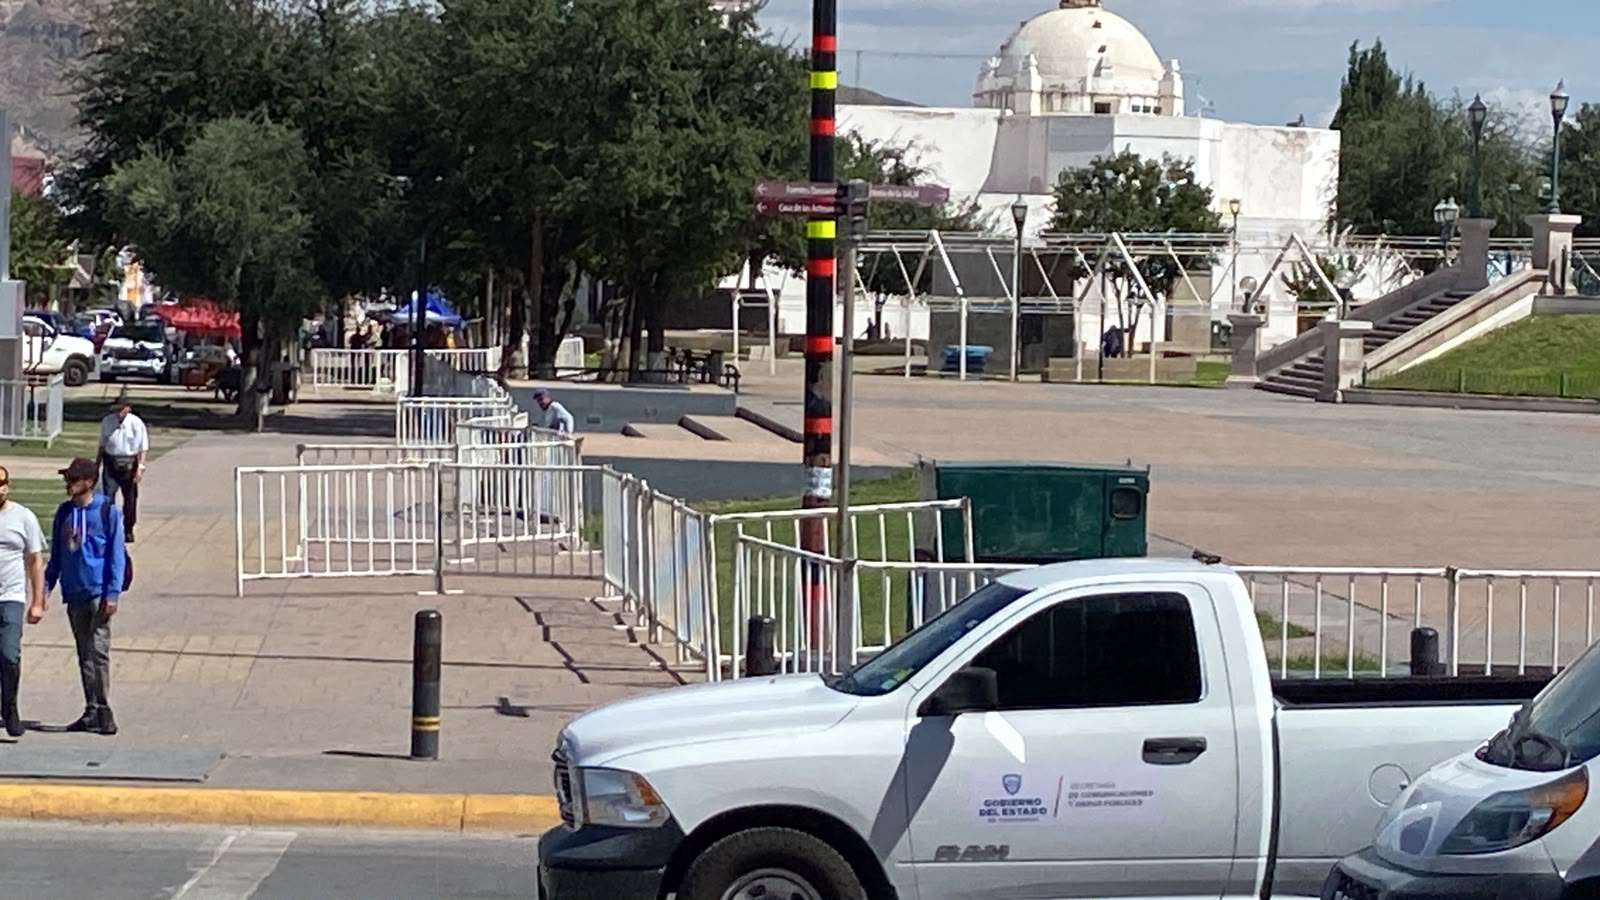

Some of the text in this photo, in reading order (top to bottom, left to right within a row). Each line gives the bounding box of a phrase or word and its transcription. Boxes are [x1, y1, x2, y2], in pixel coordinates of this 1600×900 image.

[984, 798, 1042, 807] GOBIERNO
[979, 806, 1047, 817] DEL ESTADO
[935, 845, 1010, 862] RAM
